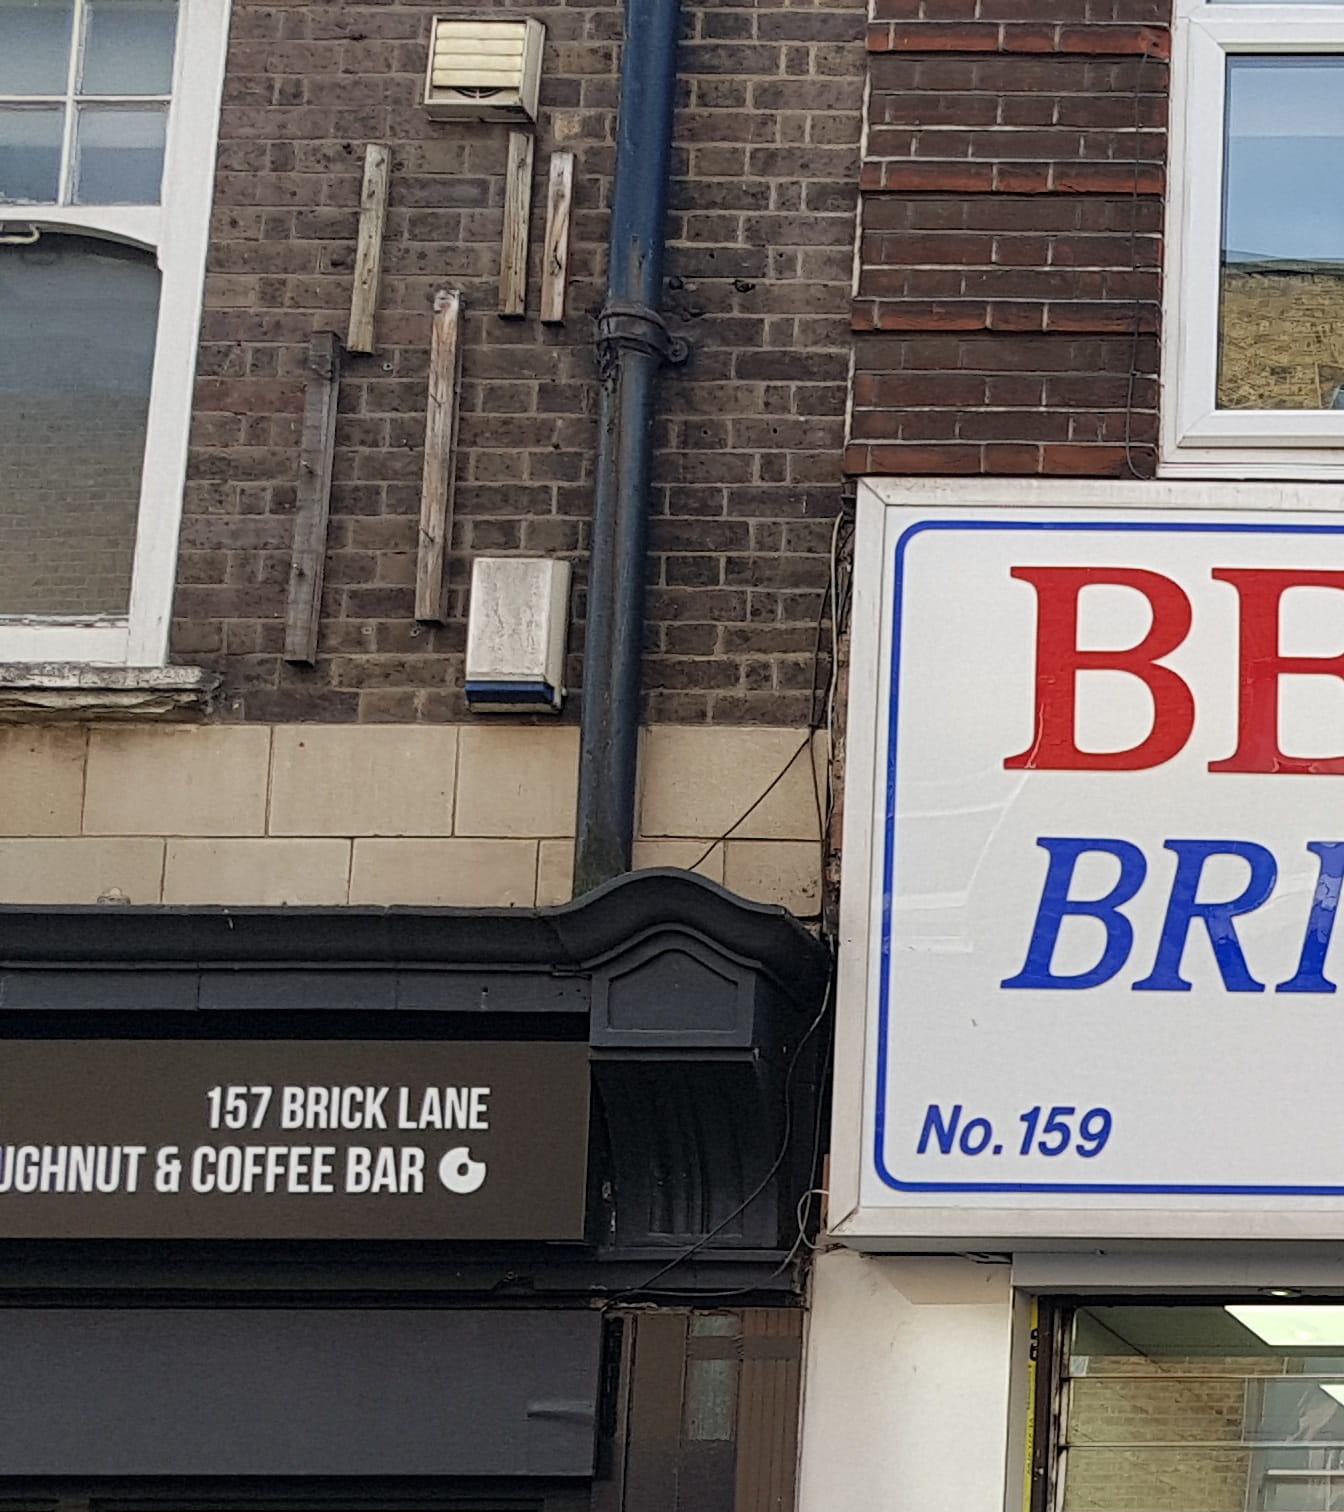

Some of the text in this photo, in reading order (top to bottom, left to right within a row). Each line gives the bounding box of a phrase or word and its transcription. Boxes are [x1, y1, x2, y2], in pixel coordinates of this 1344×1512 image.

[208, 1087, 490, 1129] 157 BRICK LANE
[156, 1147, 182, 1192] &
[192, 1146, 335, 1192] COFFEE
[346, 1147, 424, 1192] BAR
